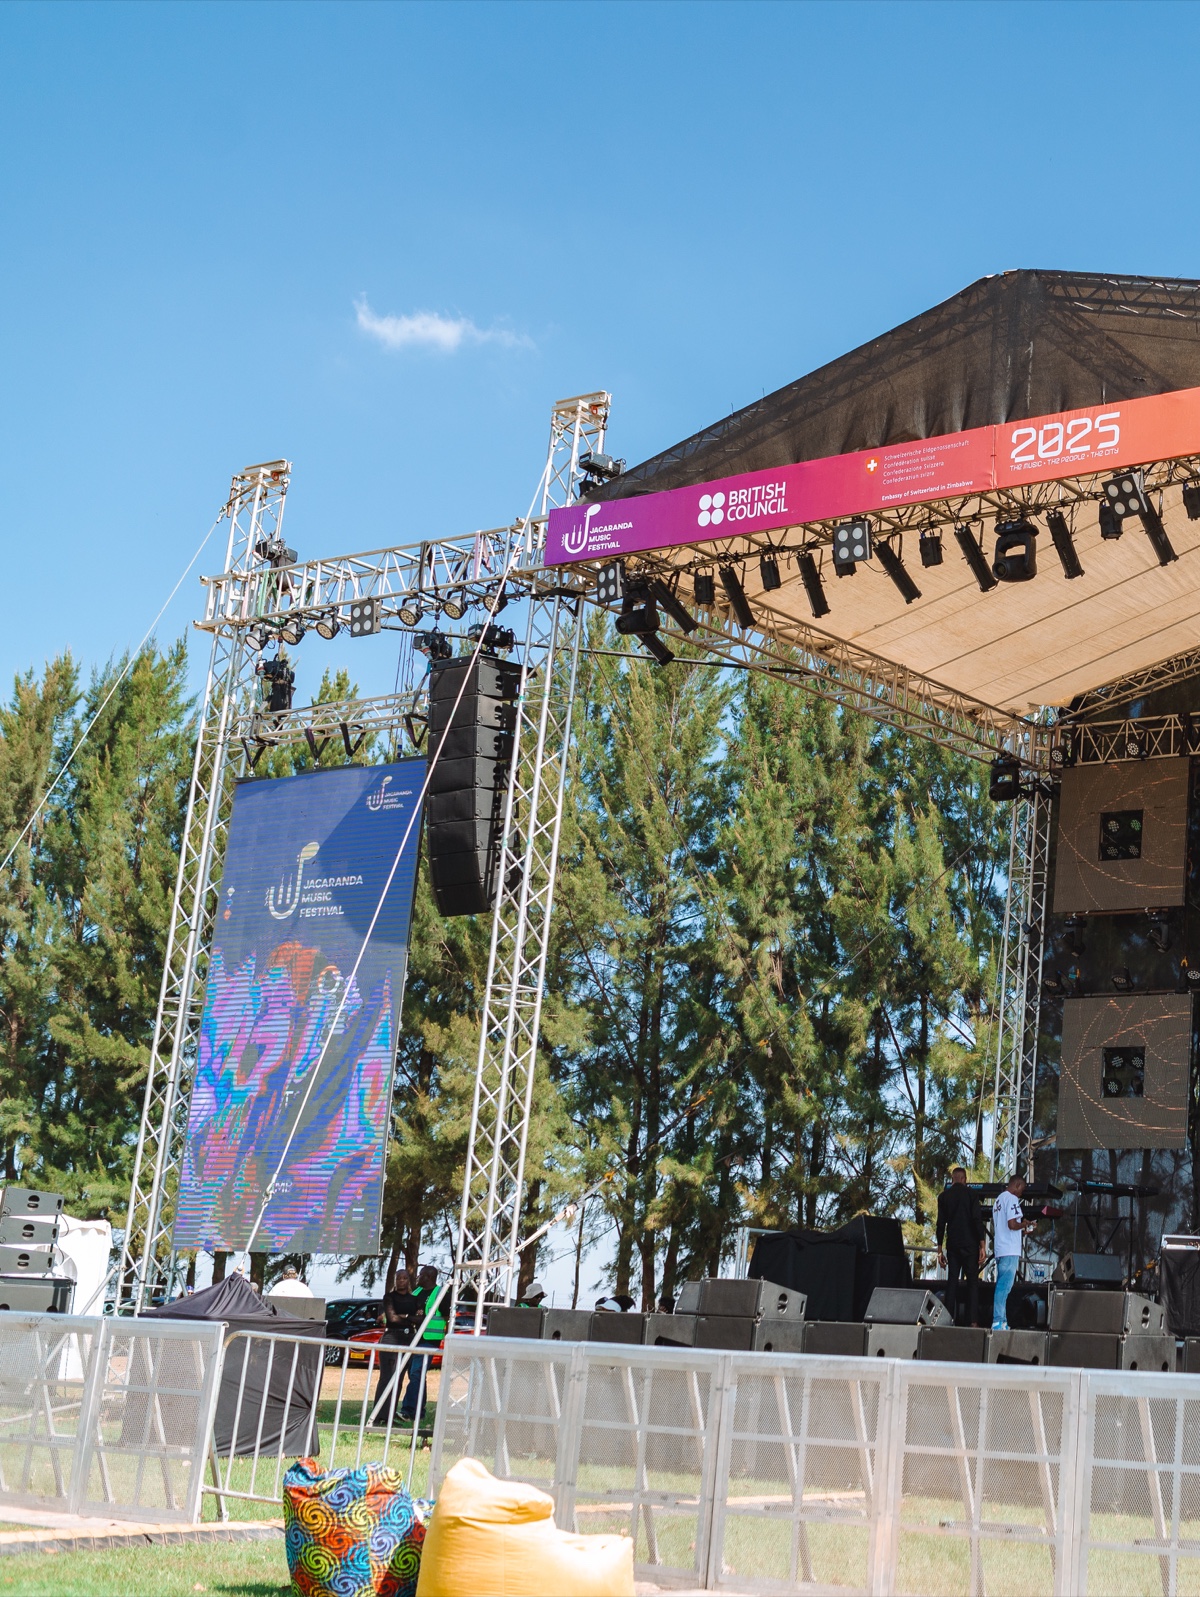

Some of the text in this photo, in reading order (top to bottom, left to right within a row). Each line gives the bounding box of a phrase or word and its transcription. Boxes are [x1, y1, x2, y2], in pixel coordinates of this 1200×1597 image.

[1010, 411, 1121, 463] 2025
[728, 481, 786, 506] BRITISH
[881, 493, 903, 501] Embassy
[910, 485, 940, 496] Switzerland
[946, 480, 974, 490] Zimbabwe
[726, 497, 789, 522] COUNCIL
[589, 521, 633, 534] JACARANDA
[588, 533, 612, 543] MUSIC
[587, 541, 621, 552] FESTIVAL
[303, 874, 364, 890] JACARANDA
[301, 891, 333, 904] MUSIC
[299, 905, 345, 918] FESTIVAL
